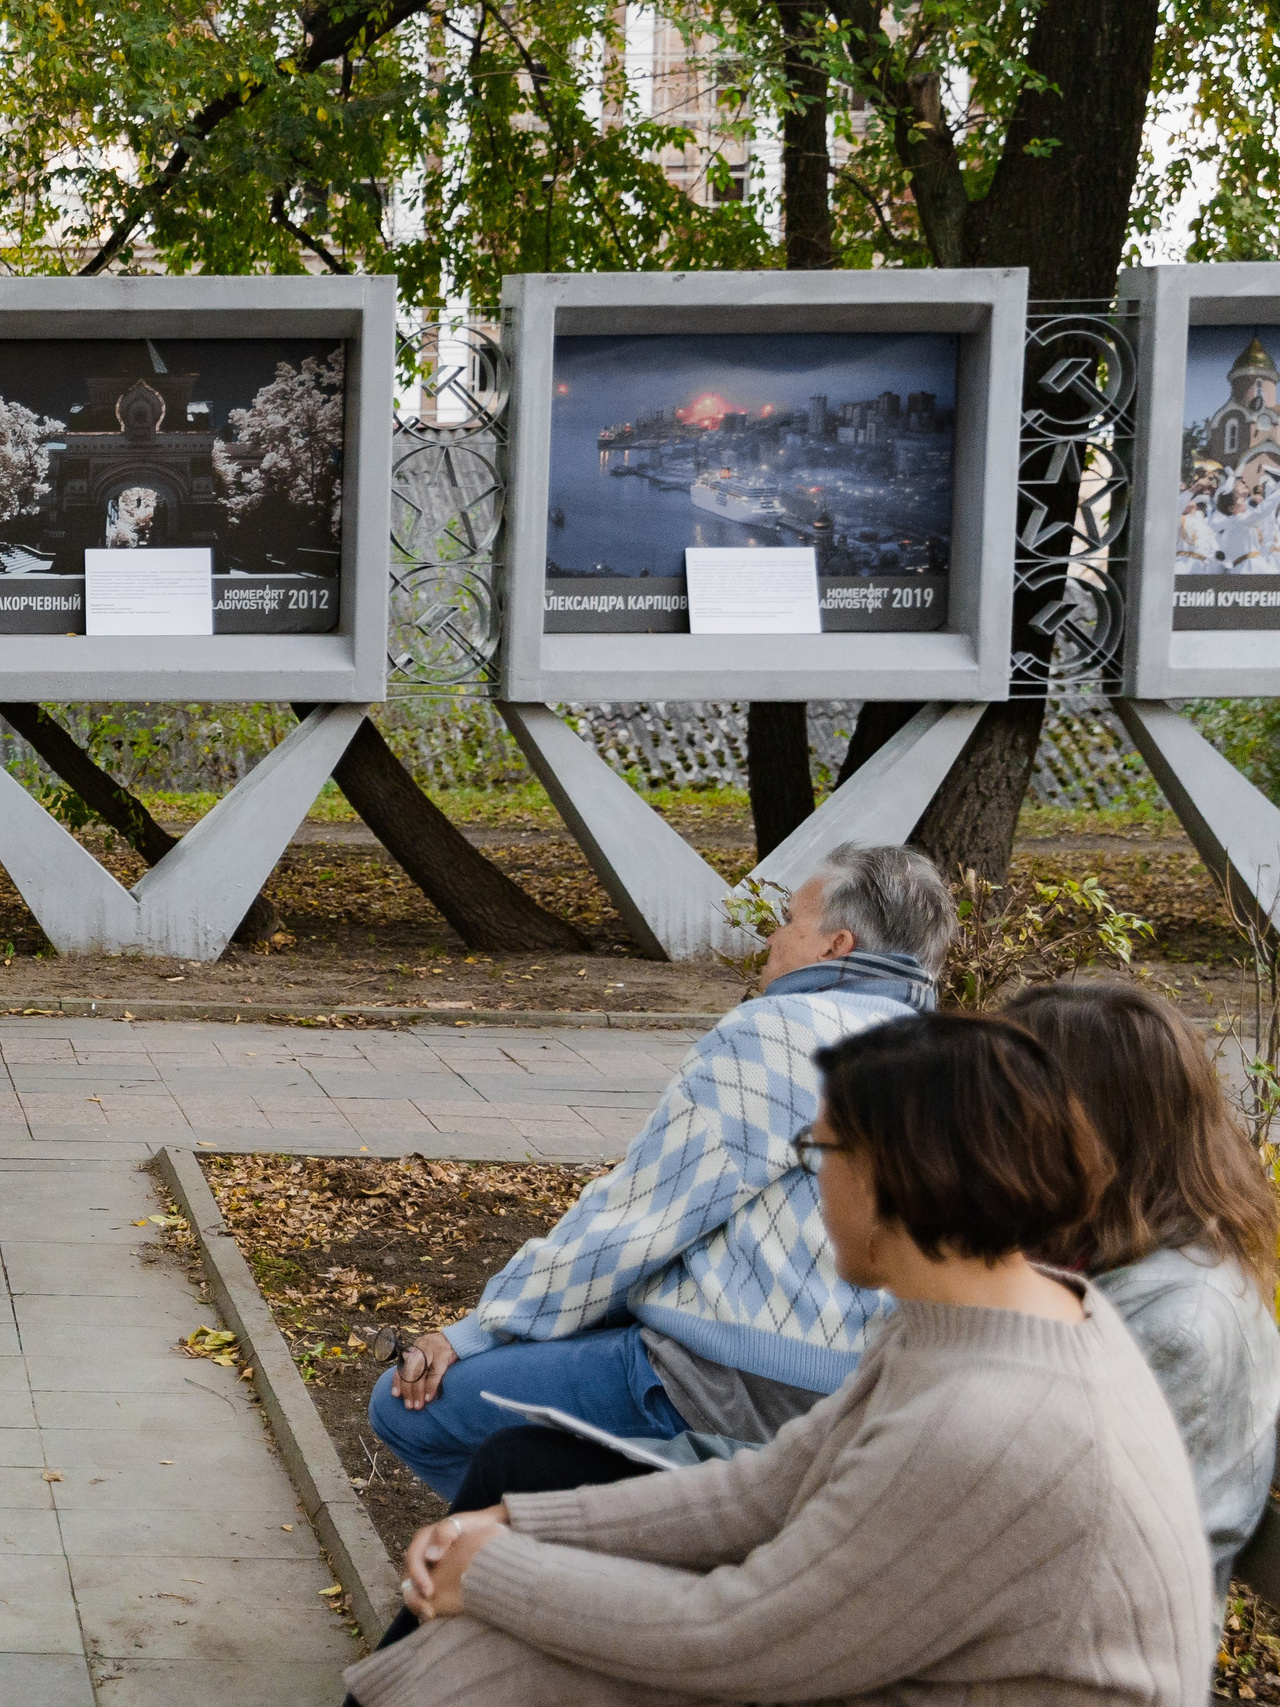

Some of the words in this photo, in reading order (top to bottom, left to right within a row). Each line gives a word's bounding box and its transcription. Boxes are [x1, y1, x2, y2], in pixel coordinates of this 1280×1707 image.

[224, 589, 285, 600] HOMEPORT
[287, 589, 329, 609] 2012
[826, 588, 889, 599] HOMEPORT
[891, 587, 934, 608] 2019
